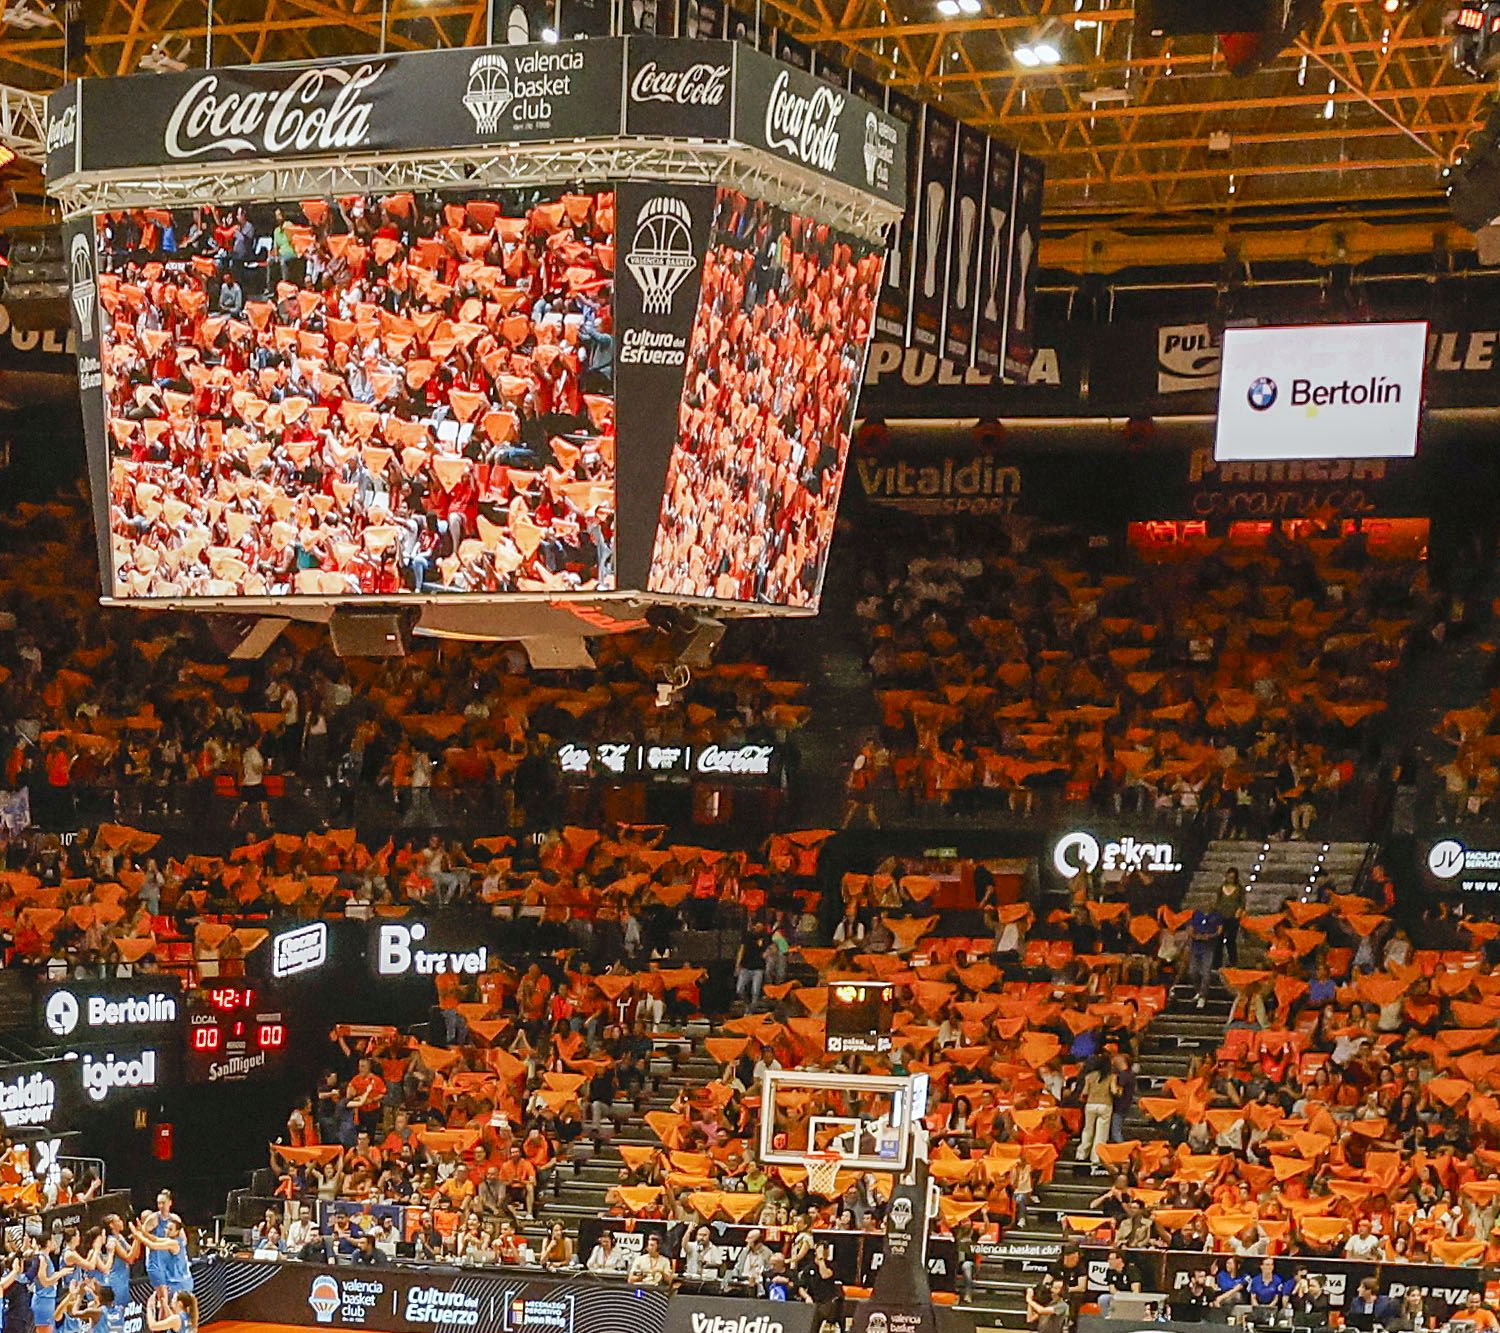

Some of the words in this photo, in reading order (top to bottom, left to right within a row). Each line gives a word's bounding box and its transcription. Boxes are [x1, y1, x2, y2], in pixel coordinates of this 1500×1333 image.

[515, 50, 583, 73] valencia
[515, 74, 570, 98] basket
[631, 62, 730, 105] Coca-Cola
[165, 64, 385, 157] Coca-Cola
[513, 98, 551, 120] club
[766, 71, 845, 171] Coca-Cola
[623, 329, 671, 348] Cultura
[620, 347, 685, 366] Esfuerzo
[1291, 377, 1401, 406] Bertolín
[856, 456, 1020, 495] Vitaldin
[89, 994, 175, 1025] Bertolín
[192, 1015, 217, 1024] LOCAL
[196, 1029, 217, 1047] 00
[261, 1026, 281, 1044] 00
[970, 1243, 1006, 1255] valencia
[1008, 1244, 1039, 1256] basket
[1041, 1245, 1061, 1254] club
[342, 1280, 383, 1295] valencia
[407, 1286, 463, 1306] Cultura
[464, 1296, 479, 1307] del
[342, 1293, 377, 1305] basket
[341, 1304, 365, 1317] club
[406, 1303, 478, 1326] Esfuerzo
[524, 1314, 544, 1326] Juan
[544, 1316, 567, 1328] Roig
